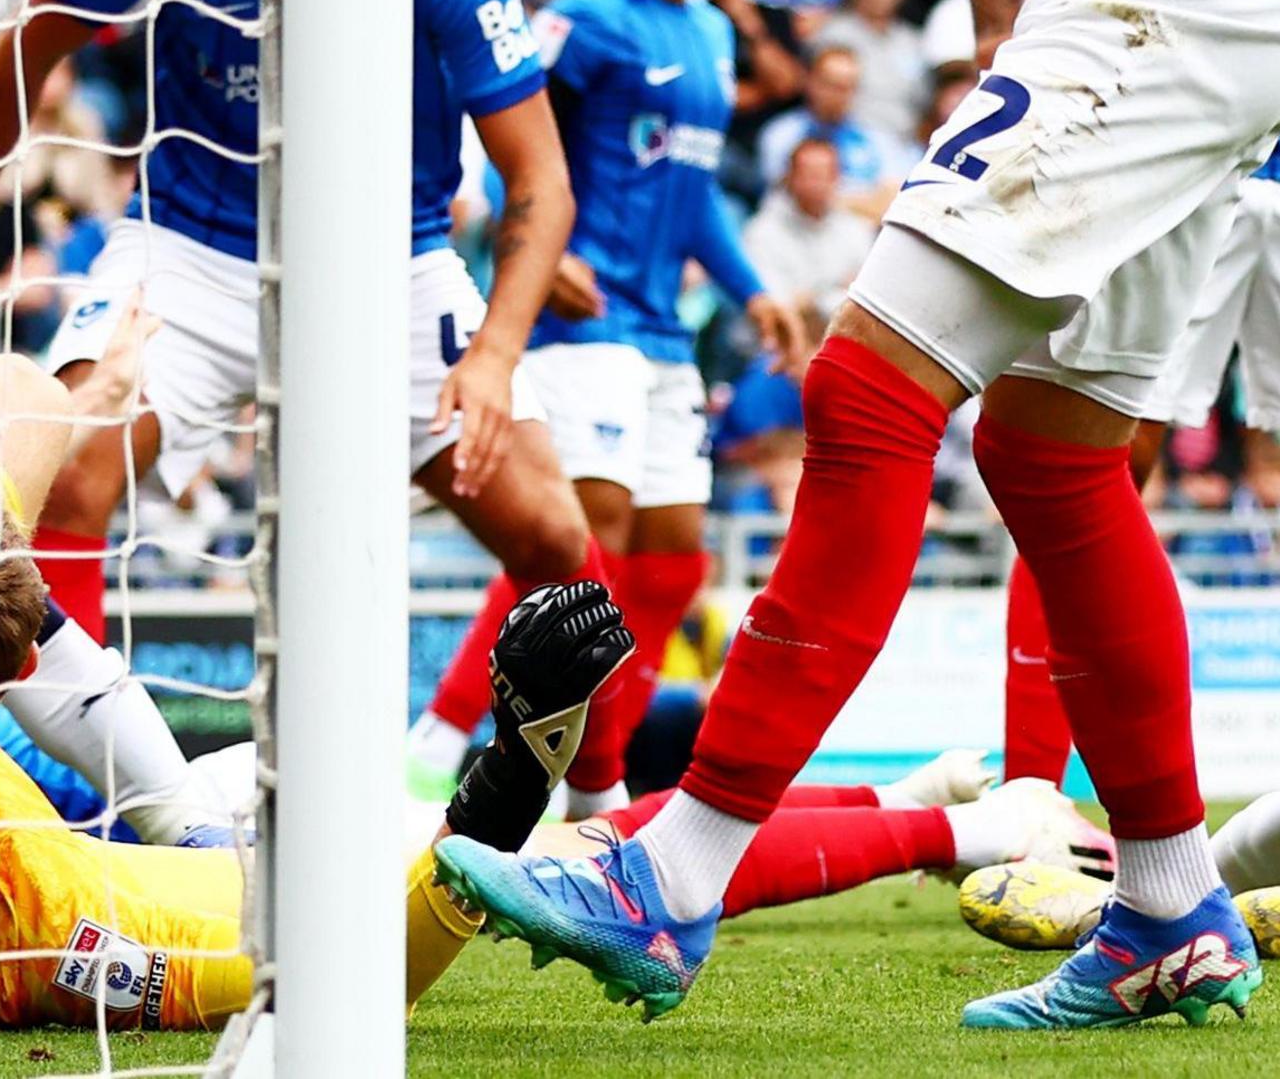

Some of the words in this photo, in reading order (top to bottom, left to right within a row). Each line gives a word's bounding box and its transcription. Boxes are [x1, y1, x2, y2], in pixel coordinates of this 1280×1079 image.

[930, 73, 1031, 182] 2
[63, 958, 85, 988] sky
[129, 975, 147, 998] EFL
